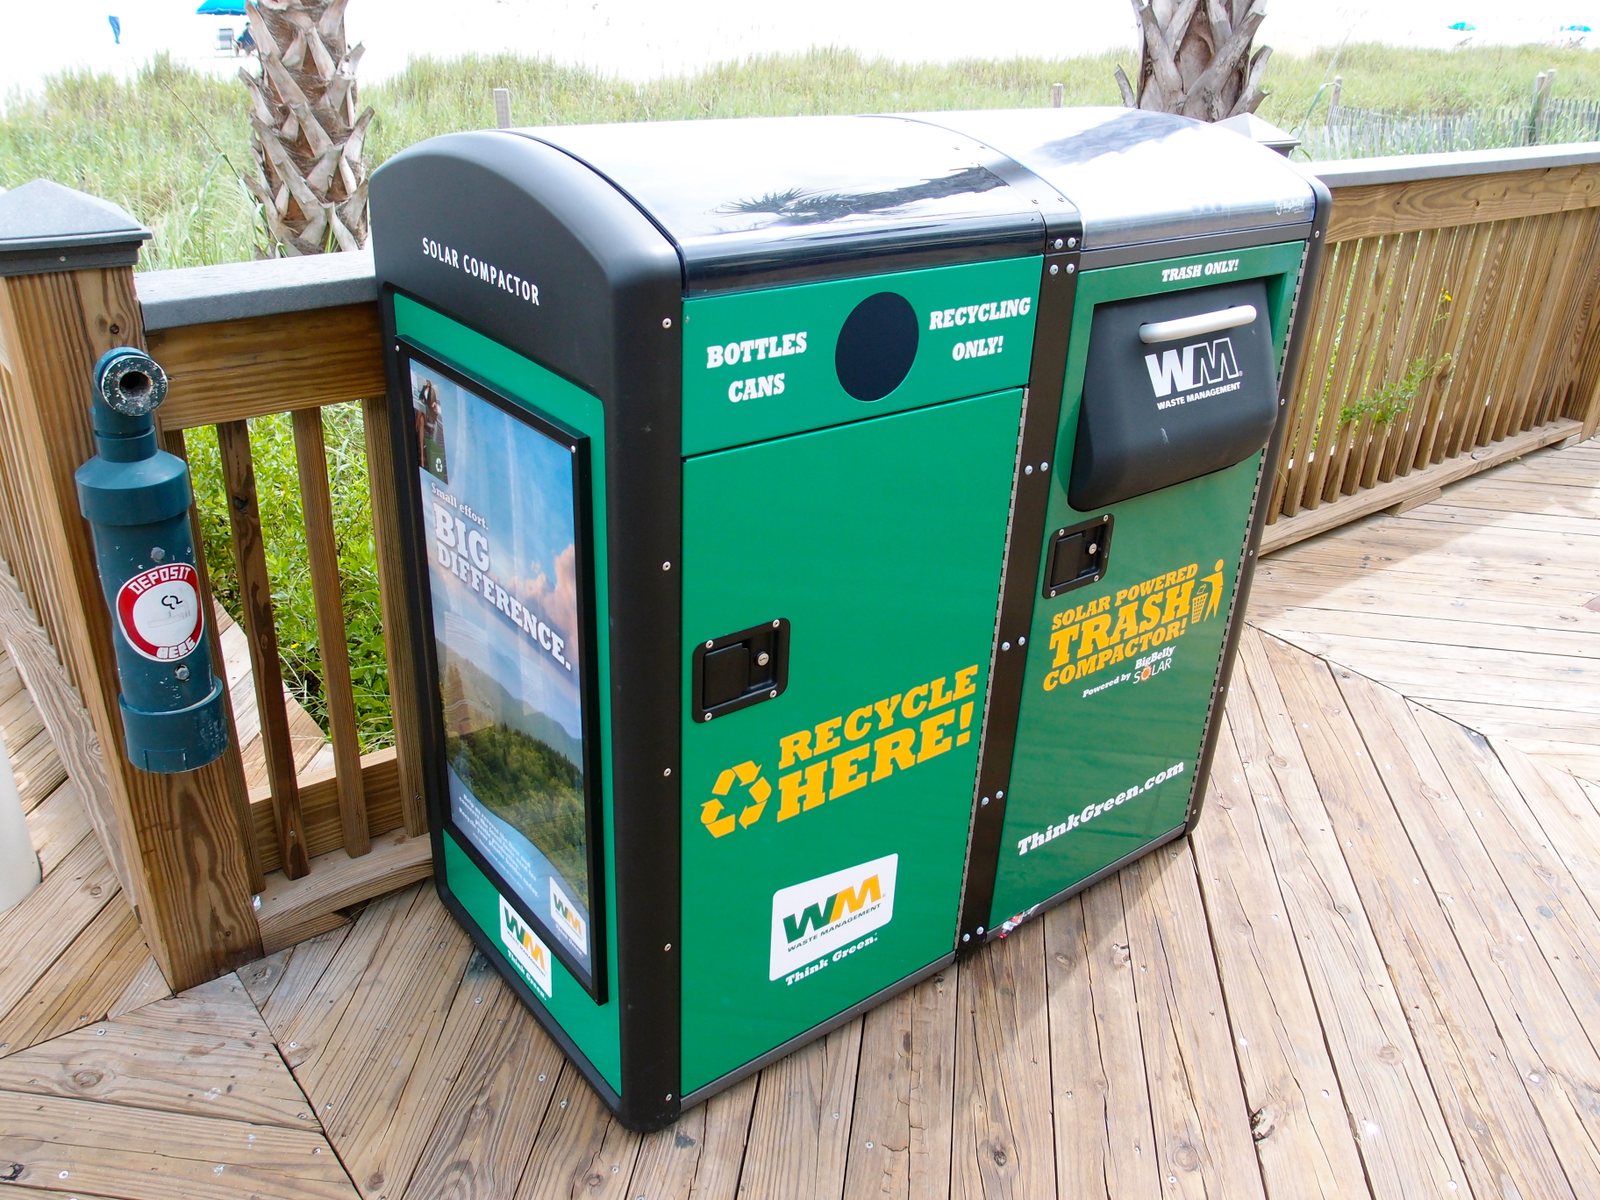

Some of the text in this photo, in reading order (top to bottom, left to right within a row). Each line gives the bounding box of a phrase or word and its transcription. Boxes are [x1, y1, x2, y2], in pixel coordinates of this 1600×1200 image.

[422, 237, 540, 306] SOLAR COMPACTOR
[1161, 258, 1240, 282] TRASH ONLY!
[928, 297, 1032, 330] RECYCLING
[706, 331, 808, 369] BOTTLES
[951, 335, 1004, 361] ONLY!
[1144, 337, 1239, 398] WM
[727, 373, 786, 404] CANS
[1156, 381, 1241, 411] WASTE MANAGEMENT
[431, 482, 489, 530] Small effort.
[433, 502, 491, 572] BIG
[127, 566, 191, 594] DEPOSIT
[1051, 563, 1199, 631] SOLAR POWERED
[436, 540, 572, 671] DIFFERENCE.
[1049, 579, 1196, 669] TRASH
[1043, 617, 1187, 692] COMPACTOR!
[1132, 657, 1172, 685] SOLAR
[1134, 645, 1177, 670] BigBelly
[1082, 672, 1132, 698] Powered by
[778, 664, 979, 770] RECYCLE
[776, 701, 975, 823] HERE!
[1017, 761, 1185, 856] ThinkGreen.com
[782, 874, 882, 944] WM
[787, 902, 882, 953] WASTE MANAGEMENT
[504, 905, 546, 972] WM
[507, 949, 526, 974] Think
[785, 958, 829, 986] Think
